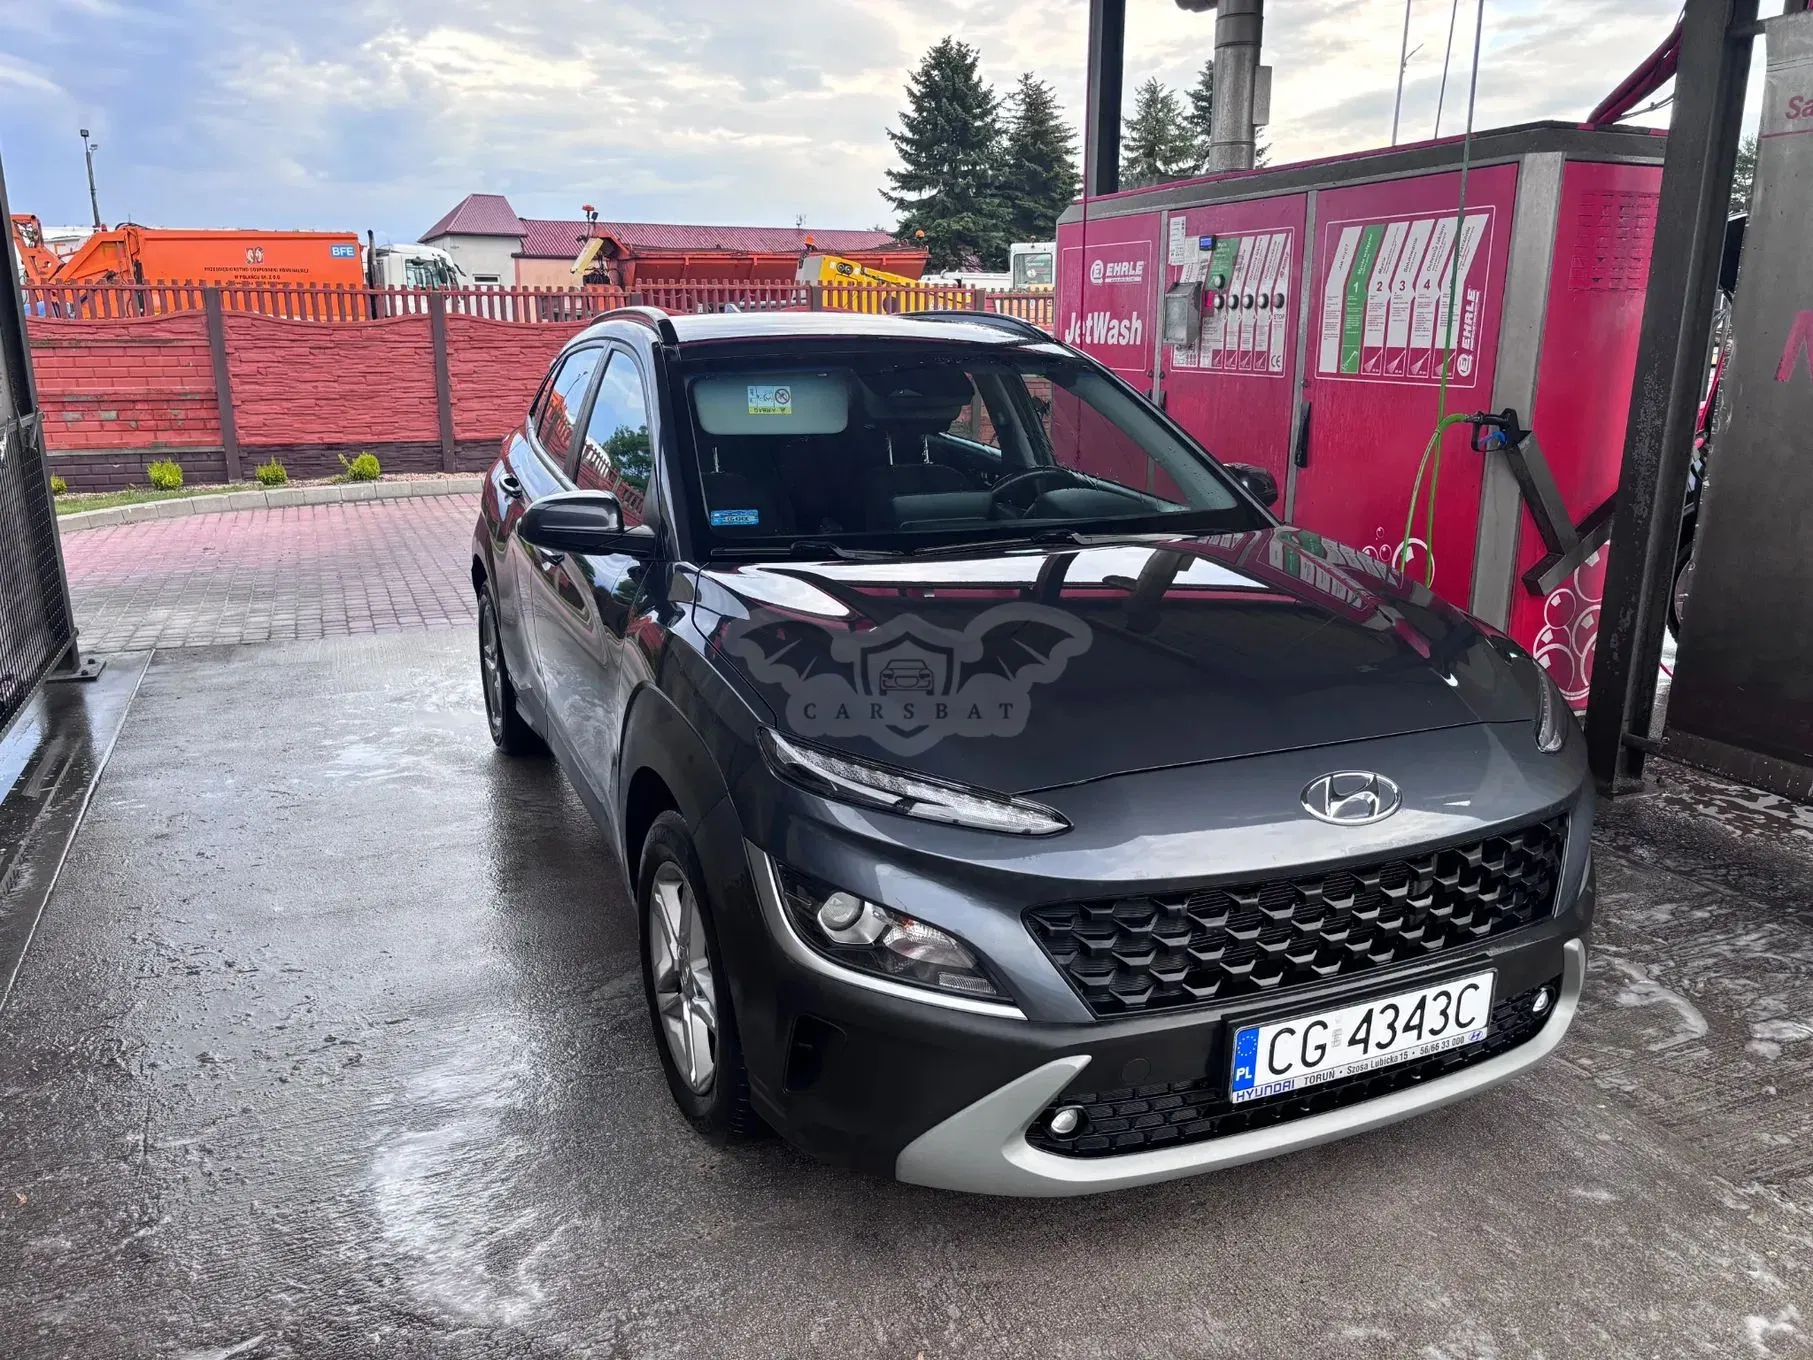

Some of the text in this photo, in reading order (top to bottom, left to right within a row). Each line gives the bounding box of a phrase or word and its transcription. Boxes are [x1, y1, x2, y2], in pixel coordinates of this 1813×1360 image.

[331, 246, 354, 257] BFE
[1105, 260, 1144, 277] EHRLE
[1353, 281, 1359, 293] 1
[1376, 281, 1383, 292] 2
[1399, 280, 1406, 291] 3
[1423, 278, 1431, 290] 4
[1461, 287, 1476, 350] EHRLE
[1064, 311, 1143, 345] JetWash
[1268, 1020, 1328, 1076] CG
[1347, 983, 1480, 1054] 4343C
[1236, 1079, 1295, 1102] HYUNDAI
[1346, 1063, 1369, 1075] Szosa
[1400, 1051, 1409, 1061] 15
[1441, 1039, 1450, 1050] 33
[1452, 1035, 1465, 1047] 000
[1236, 1066, 1253, 1081] PL
